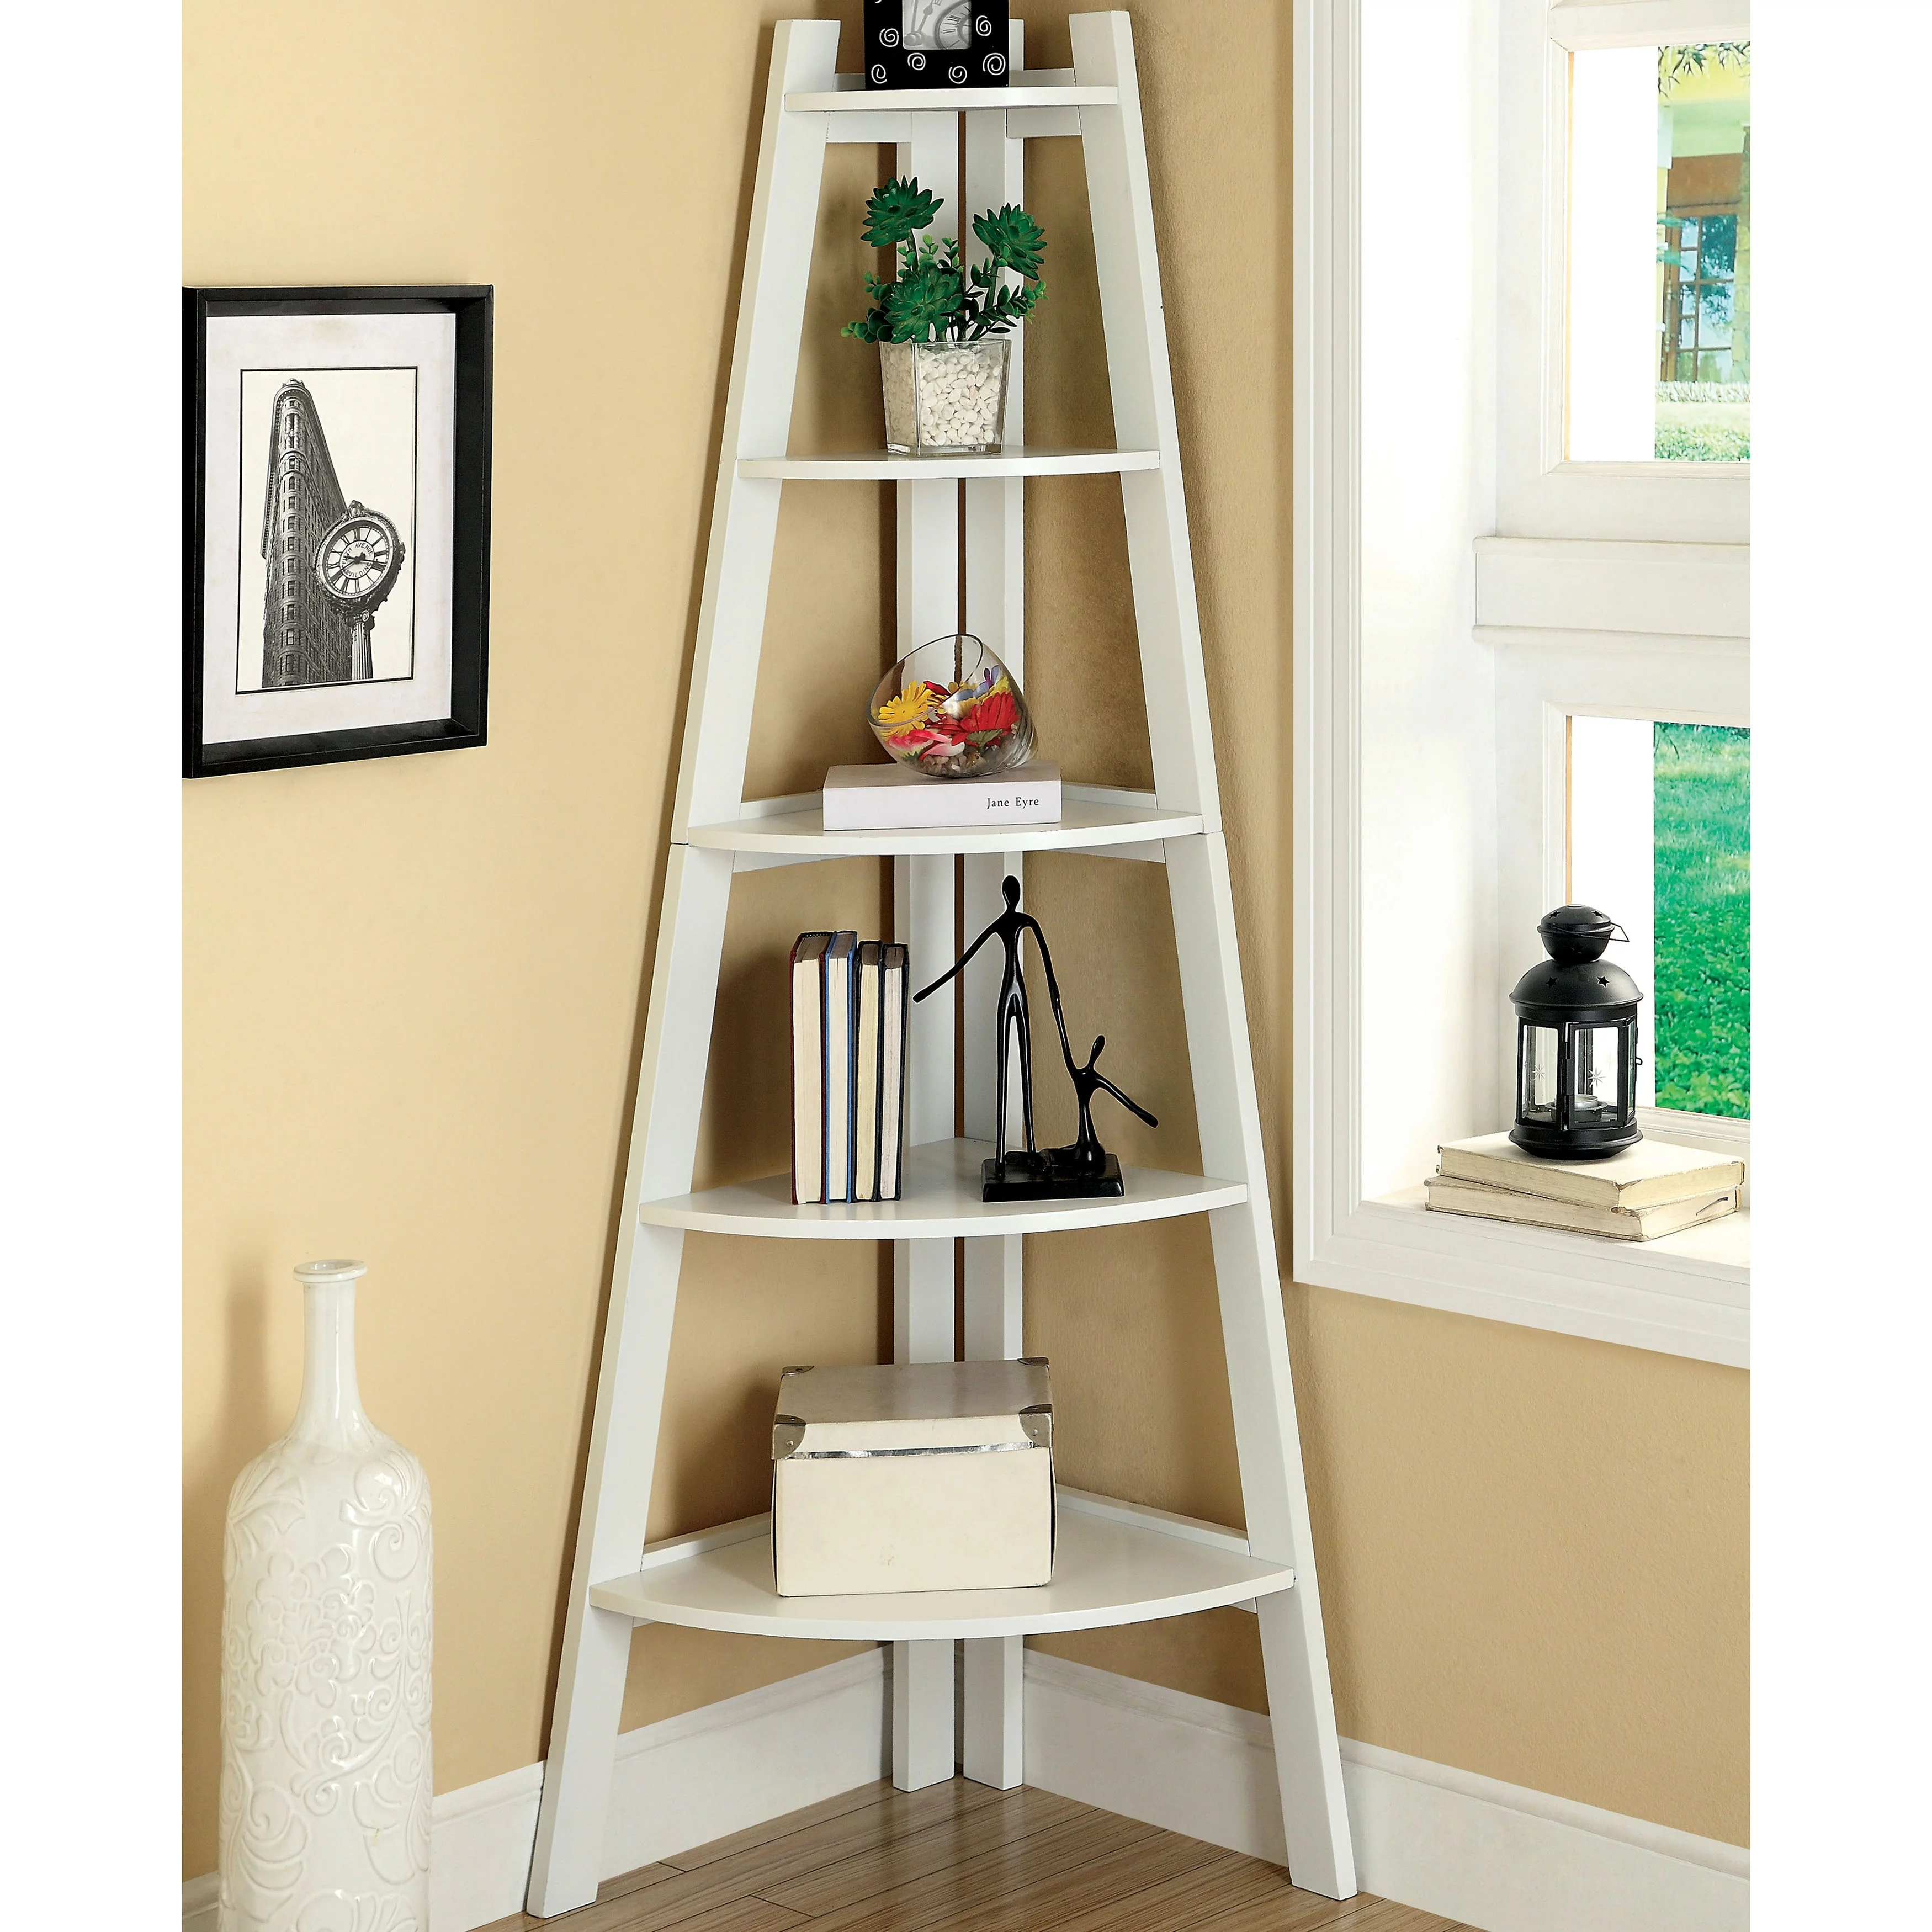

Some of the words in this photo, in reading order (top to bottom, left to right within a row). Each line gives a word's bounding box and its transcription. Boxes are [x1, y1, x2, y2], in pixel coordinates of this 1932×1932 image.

[355, 543, 373, 556] AVENUE
[345, 562, 371, 578] BUILDING
[987, 798, 1010, 809] Jane
[1016, 797, 1039, 809] Eyre
